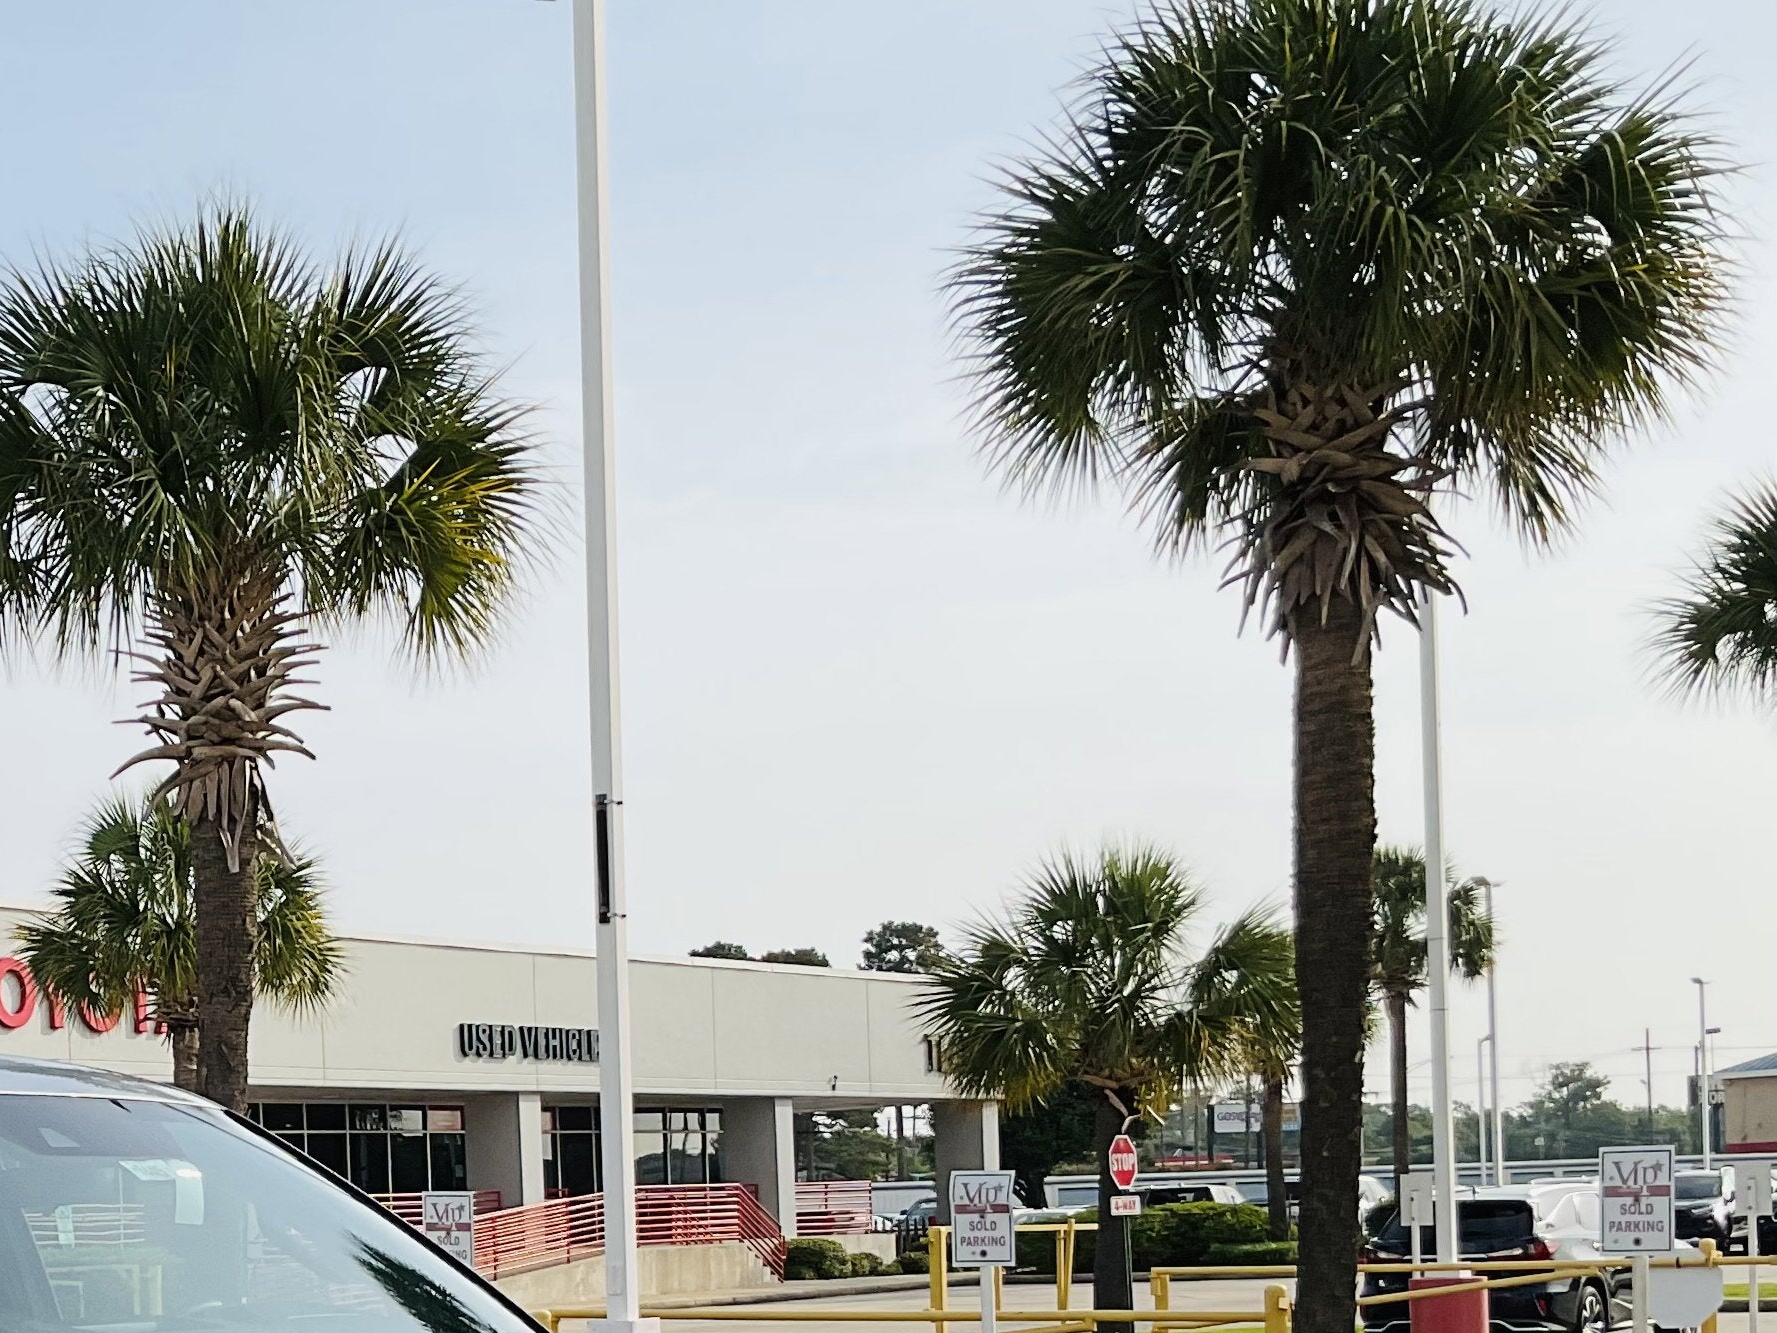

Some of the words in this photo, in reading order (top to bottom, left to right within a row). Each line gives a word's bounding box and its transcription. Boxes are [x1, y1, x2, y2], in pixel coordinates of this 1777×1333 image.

[459, 1023, 517, 1058] USED
[1111, 1153, 1135, 1172] STOP
[1114, 1199, 1136, 1211] 4-WAY
[1620, 1203, 1654, 1216] SOLD
[968, 1220, 997, 1232] SOLD
[1608, 1220, 1665, 1233] PARKING
[436, 1235, 460, 1246] SOLD
[960, 1235, 1007, 1247] PARKING
